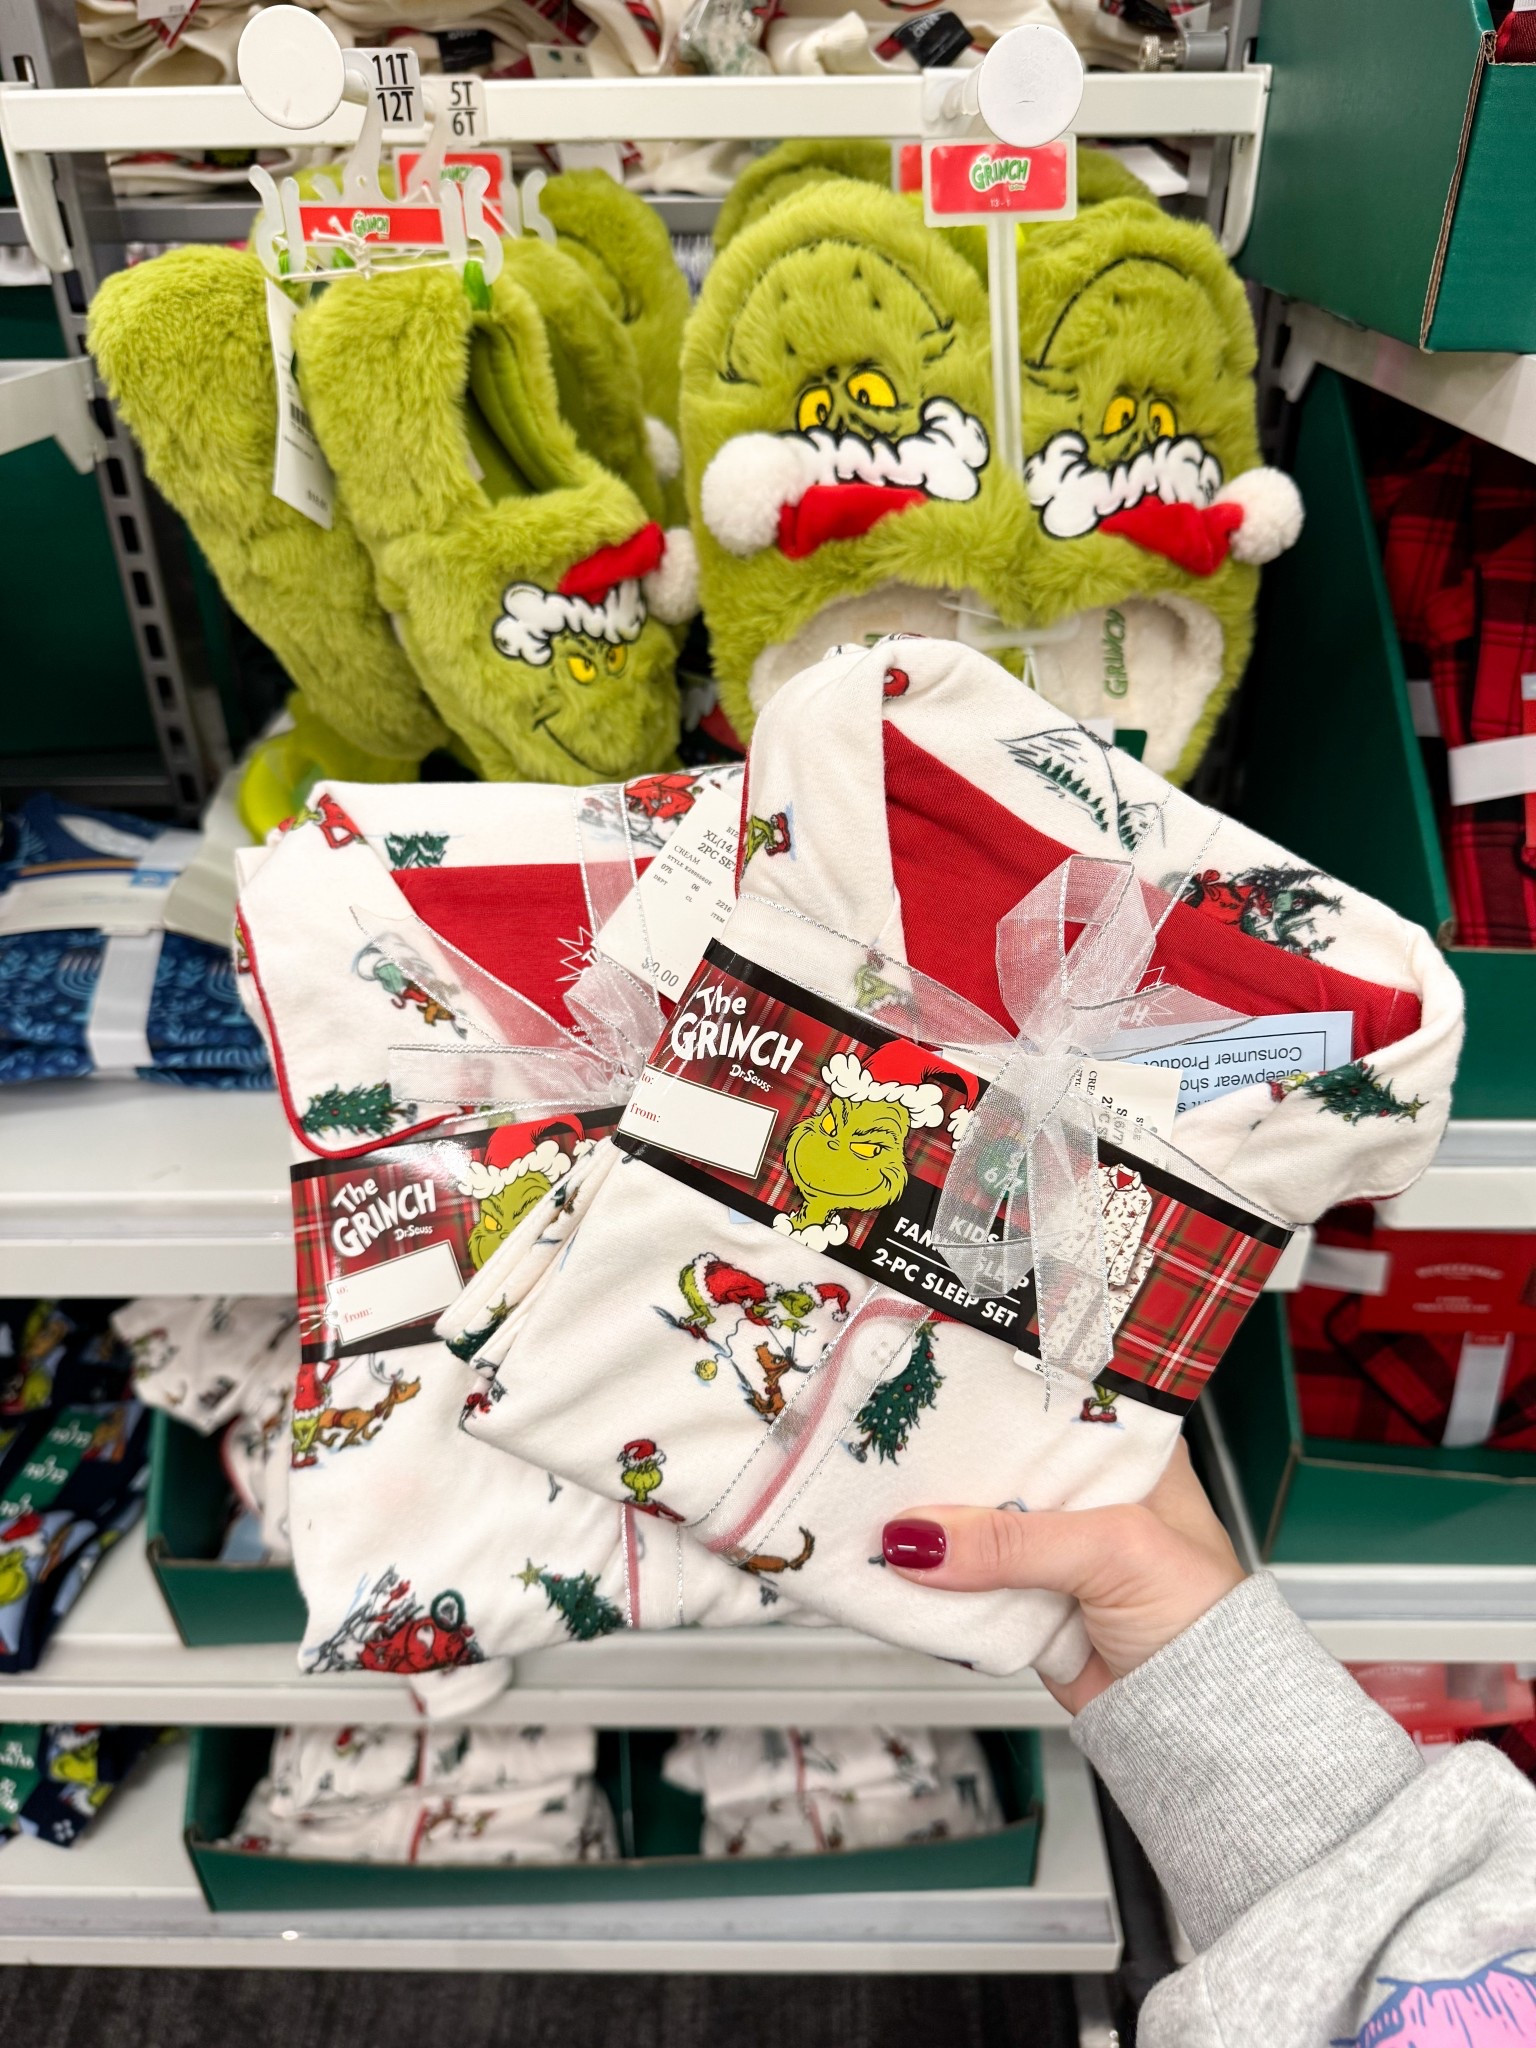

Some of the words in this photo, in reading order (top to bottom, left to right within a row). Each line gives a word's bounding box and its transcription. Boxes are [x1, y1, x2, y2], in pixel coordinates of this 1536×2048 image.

[372, 53, 408, 85] 11T
[377, 91, 413, 122] 12T
[451, 81, 473, 106] 5T
[453, 111, 475, 136] 6T
[972, 159, 1029, 190] GRINCH
[1104, 609, 1129, 700] GRINCH
[667, 854, 684, 868] STYLE
[674, 845, 700, 866] CREAM
[697, 843, 719, 861] 2PC
[653, 874, 669, 887] DEPT
[685, 895, 694, 904] CL
[710, 912, 726, 925] ITEM
[660, 863, 674, 875] 075
[691, 883, 701, 893] 06
[715, 899, 734, 914] 2216
[696, 985, 747, 1016] The
[671, 1012, 804, 1075] GRINCH
[1214, 1046, 1302, 1065] Consumer
[641, 1070, 655, 1086] to:
[630, 1102, 662, 1124] from:
[332, 1178, 379, 1213] The
[332, 1179, 437, 1258] GRINCH
[871, 1248, 921, 1283] 2-PC
[921, 1273, 981, 1309] SLEEP
[980, 1301, 1019, 1328] SET
[343, 1305, 374, 1325] from:
